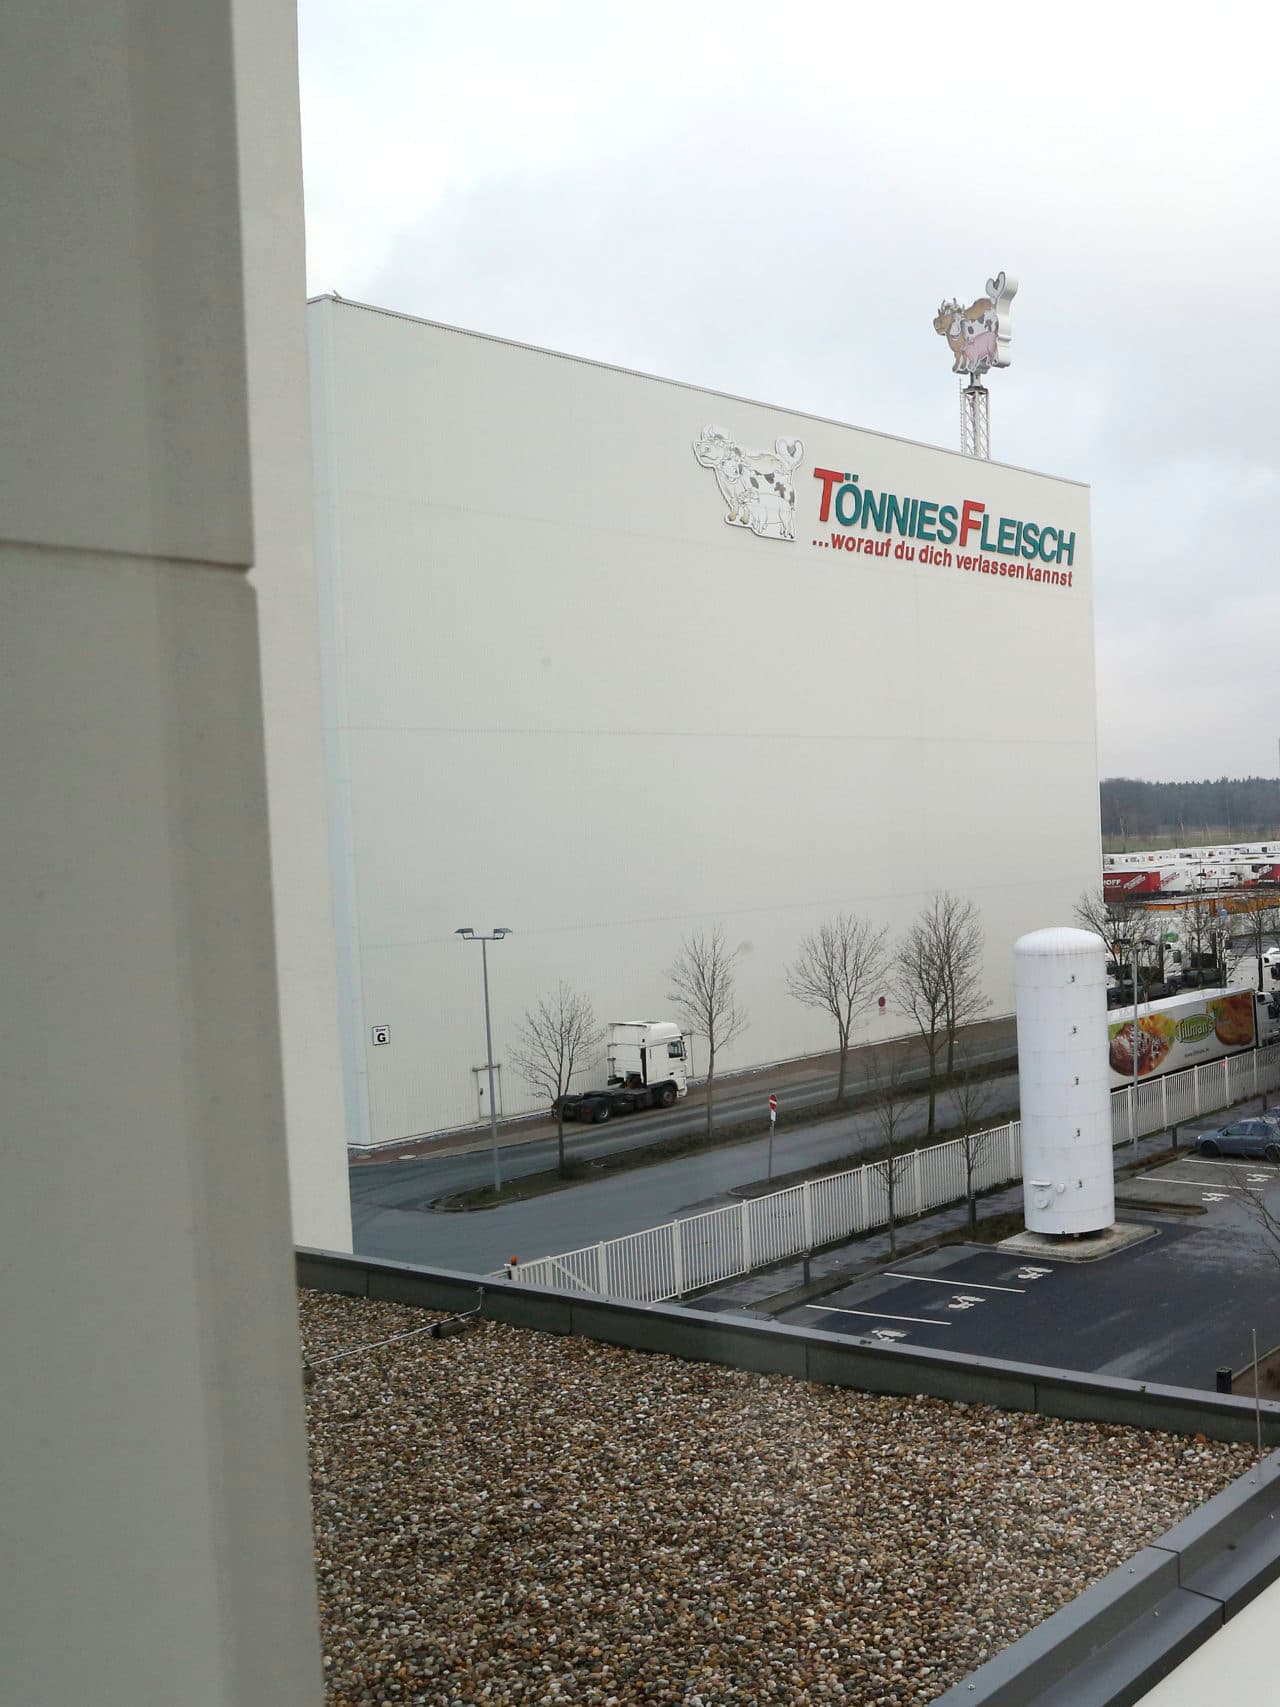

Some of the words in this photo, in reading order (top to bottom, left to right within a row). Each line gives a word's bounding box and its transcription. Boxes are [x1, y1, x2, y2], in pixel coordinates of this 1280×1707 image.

[894, 540, 915, 562] du
[918, 544, 953, 568] dich
[377, 1032, 386, 1043] G
